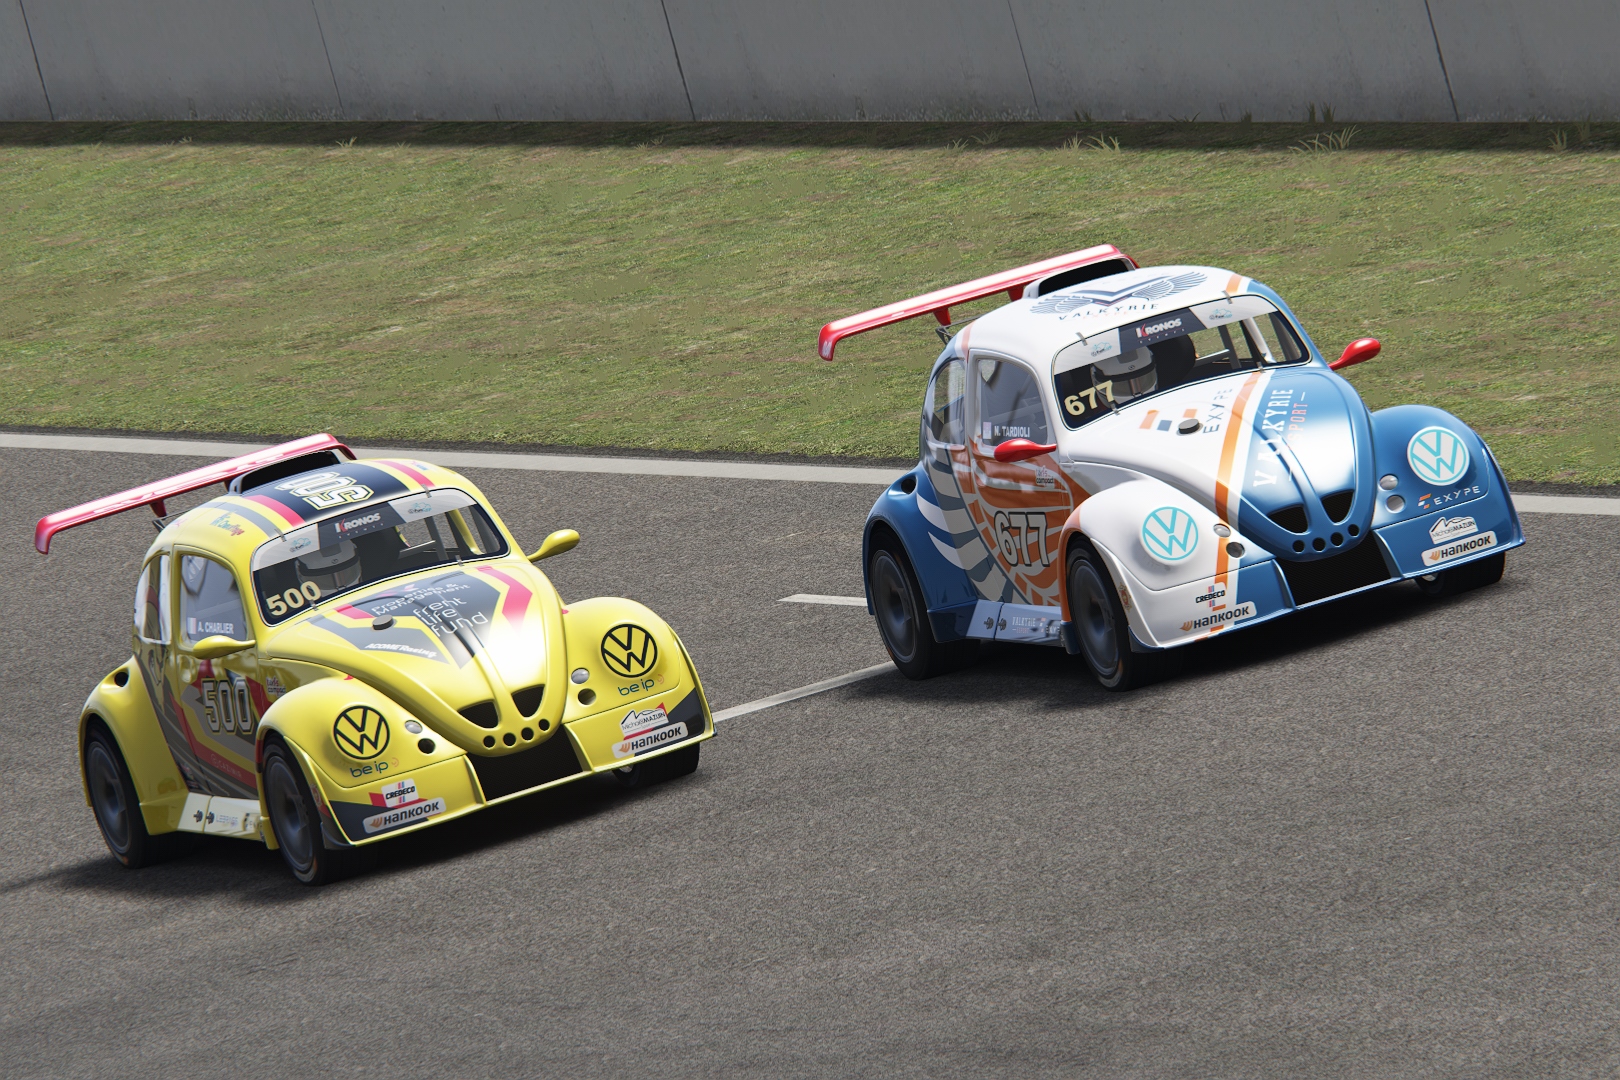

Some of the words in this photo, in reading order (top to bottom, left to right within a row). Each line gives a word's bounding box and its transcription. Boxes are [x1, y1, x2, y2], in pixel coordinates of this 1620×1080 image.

[1059, 303, 1159, 321] VALKYRIE
[1135, 317, 1183, 338] KRONOS
[1064, 379, 1115, 416] 677
[1002, 425, 1031, 438] TARDIOLI
[1433, 485, 1481, 506] EXYPE
[335, 512, 381, 533] KRONOS
[994, 510, 1051, 567] 677
[265, 580, 322, 616] 500
[1195, 589, 1226, 604] CREDECO
[198, 621, 205, 632] A.
[205, 621, 234, 634] CHARLIER
[618, 682, 640, 697] be
[201, 677, 255, 735] 500
[349, 763, 373, 778] be
[385, 785, 416, 800] CREDECO
